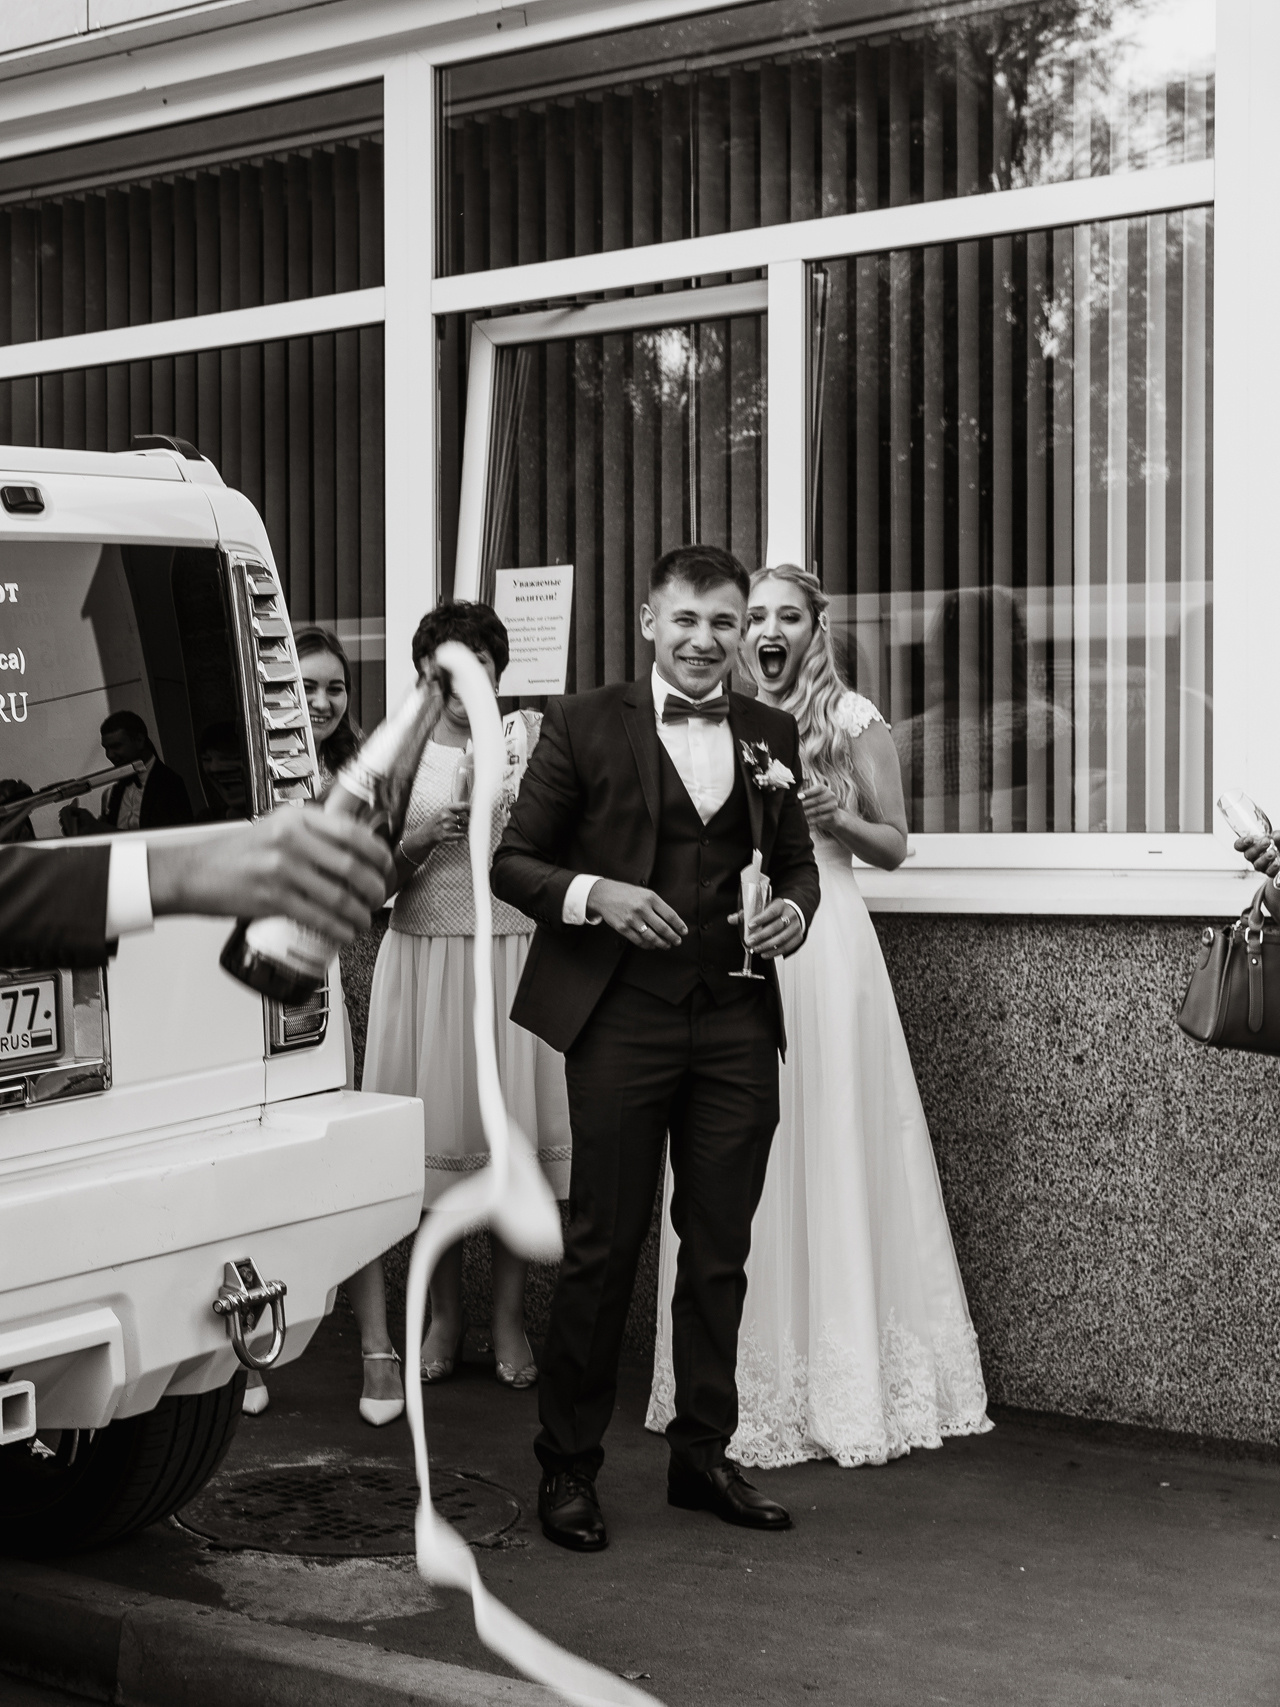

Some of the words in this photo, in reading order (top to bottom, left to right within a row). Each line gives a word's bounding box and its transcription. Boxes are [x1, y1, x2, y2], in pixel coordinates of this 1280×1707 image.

[512, 579, 561, 588] Уважаемые
[515, 592, 557, 602] водители!
[0, 987, 40, 1034] 77
[0, 1034, 30, 1052] RUS
